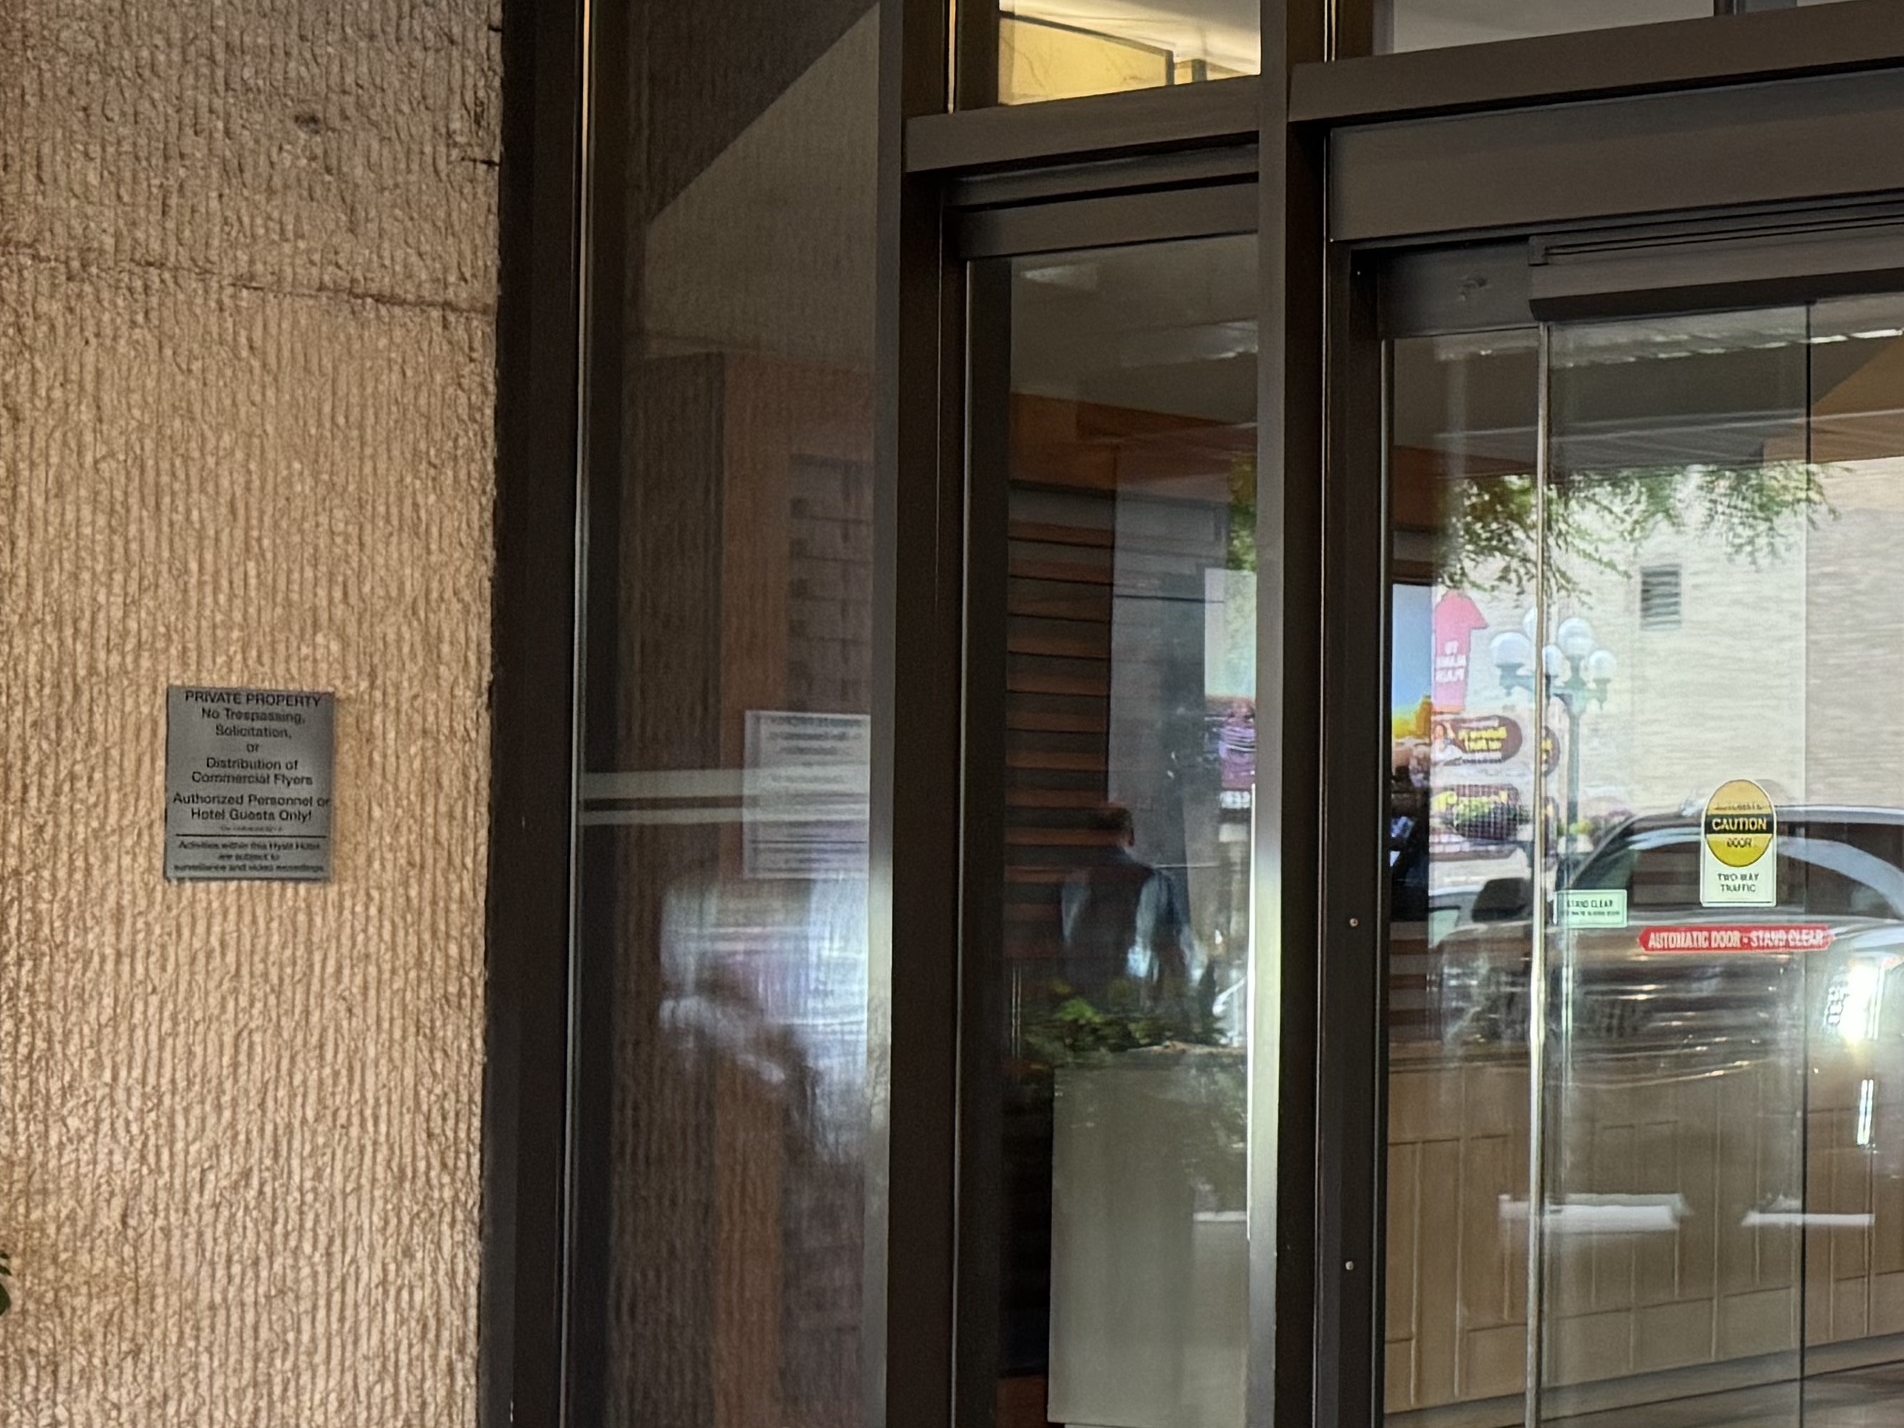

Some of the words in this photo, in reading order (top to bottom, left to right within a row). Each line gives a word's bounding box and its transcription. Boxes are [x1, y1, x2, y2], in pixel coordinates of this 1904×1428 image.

[185, 690, 242, 705] PRIVATE
[246, 693, 321, 708] PROPERTY
[201, 707, 220, 719] No
[225, 708, 306, 725] Trespassing,
[215, 724, 292, 739] Solicitation,
[246, 743, 260, 753] or
[206, 757, 281, 770] Distribution
[285, 759, 298, 770] of
[191, 771, 270, 784] Commercial
[274, 773, 313, 787] Flyers
[173, 792, 244, 805] Authorized
[249, 794, 313, 807] Personnel
[316, 797, 331, 807] or
[191, 808, 225, 820] Hotel
[229, 809, 275, 821] Guests
[279, 810, 312, 823] Only!
[1711, 818, 1767, 831] CAUTION
[1726, 838, 1752, 848] DOOR
[1648, 932, 1709, 949] AUTOMATIC
[1711, 931, 1741, 948] DOOR
[1750, 930, 1786, 948] STAND
[1788, 929, 1824, 946] CLEAR
